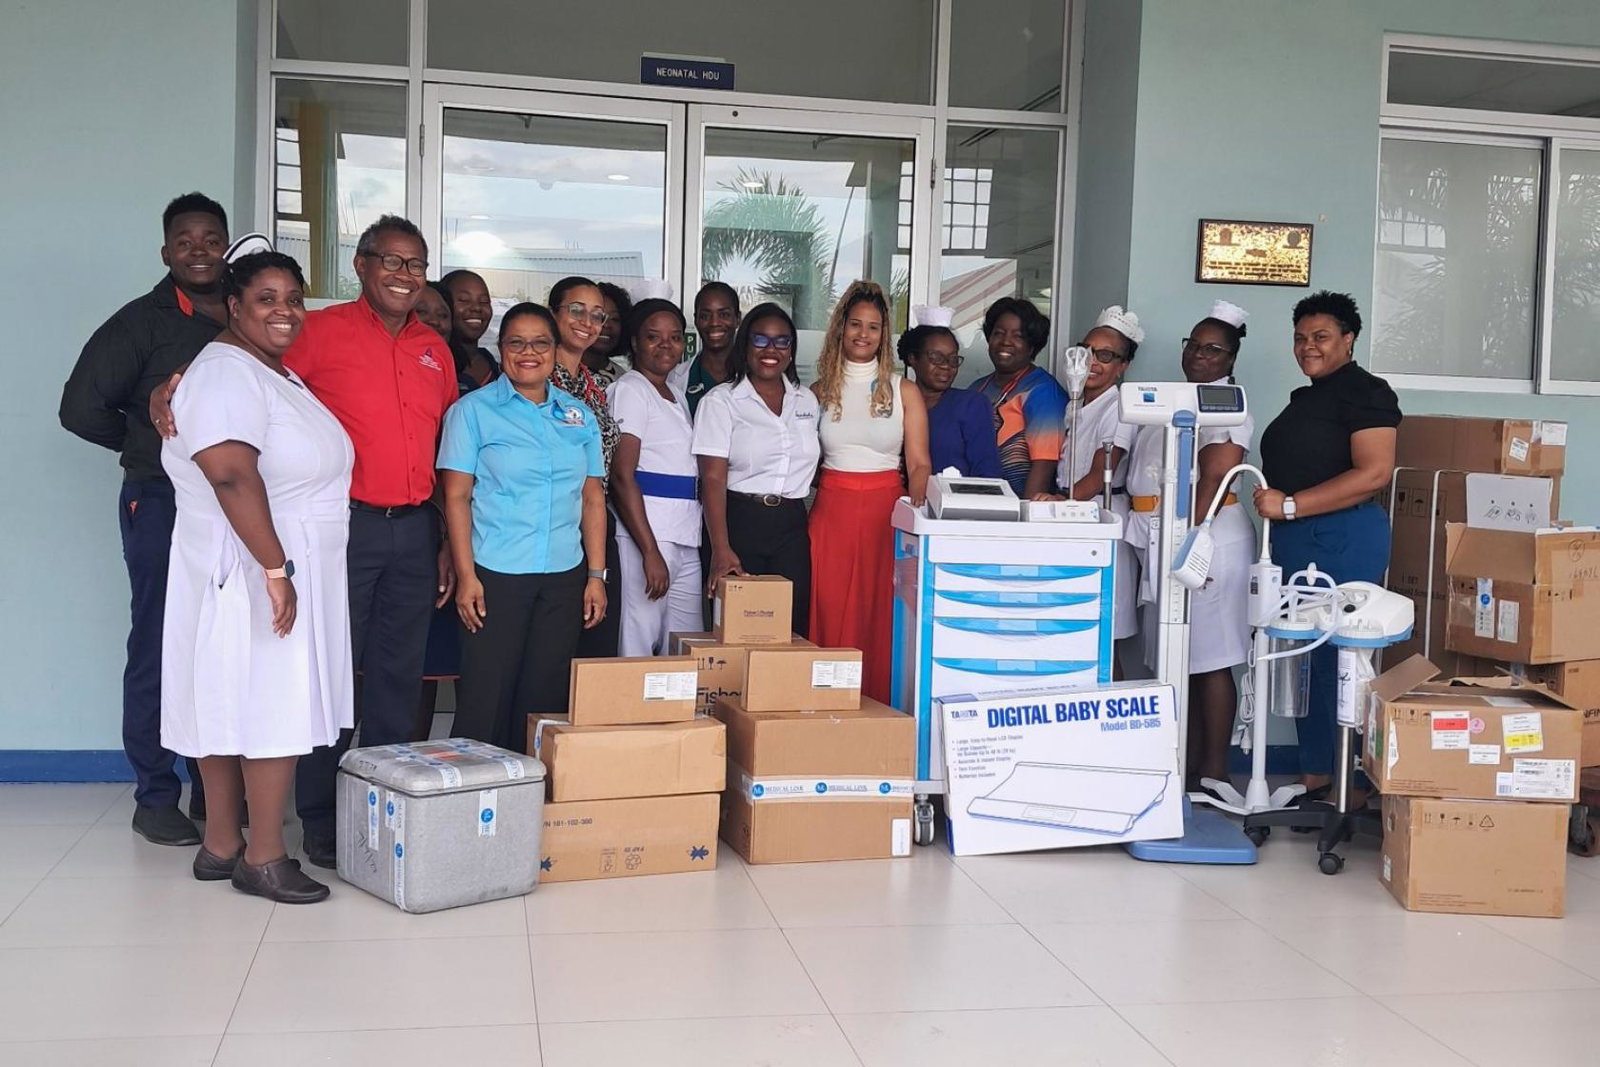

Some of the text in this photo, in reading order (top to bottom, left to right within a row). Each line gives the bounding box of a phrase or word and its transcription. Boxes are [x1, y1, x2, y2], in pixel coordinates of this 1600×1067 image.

[656, 67, 720, 80] NEONATAL HDU
[697, 687, 742, 704] Fish
[987, 695, 1160, 729] DIGITAL BABY SCALE
[1101, 716, 1162, 732] Model BD-585
